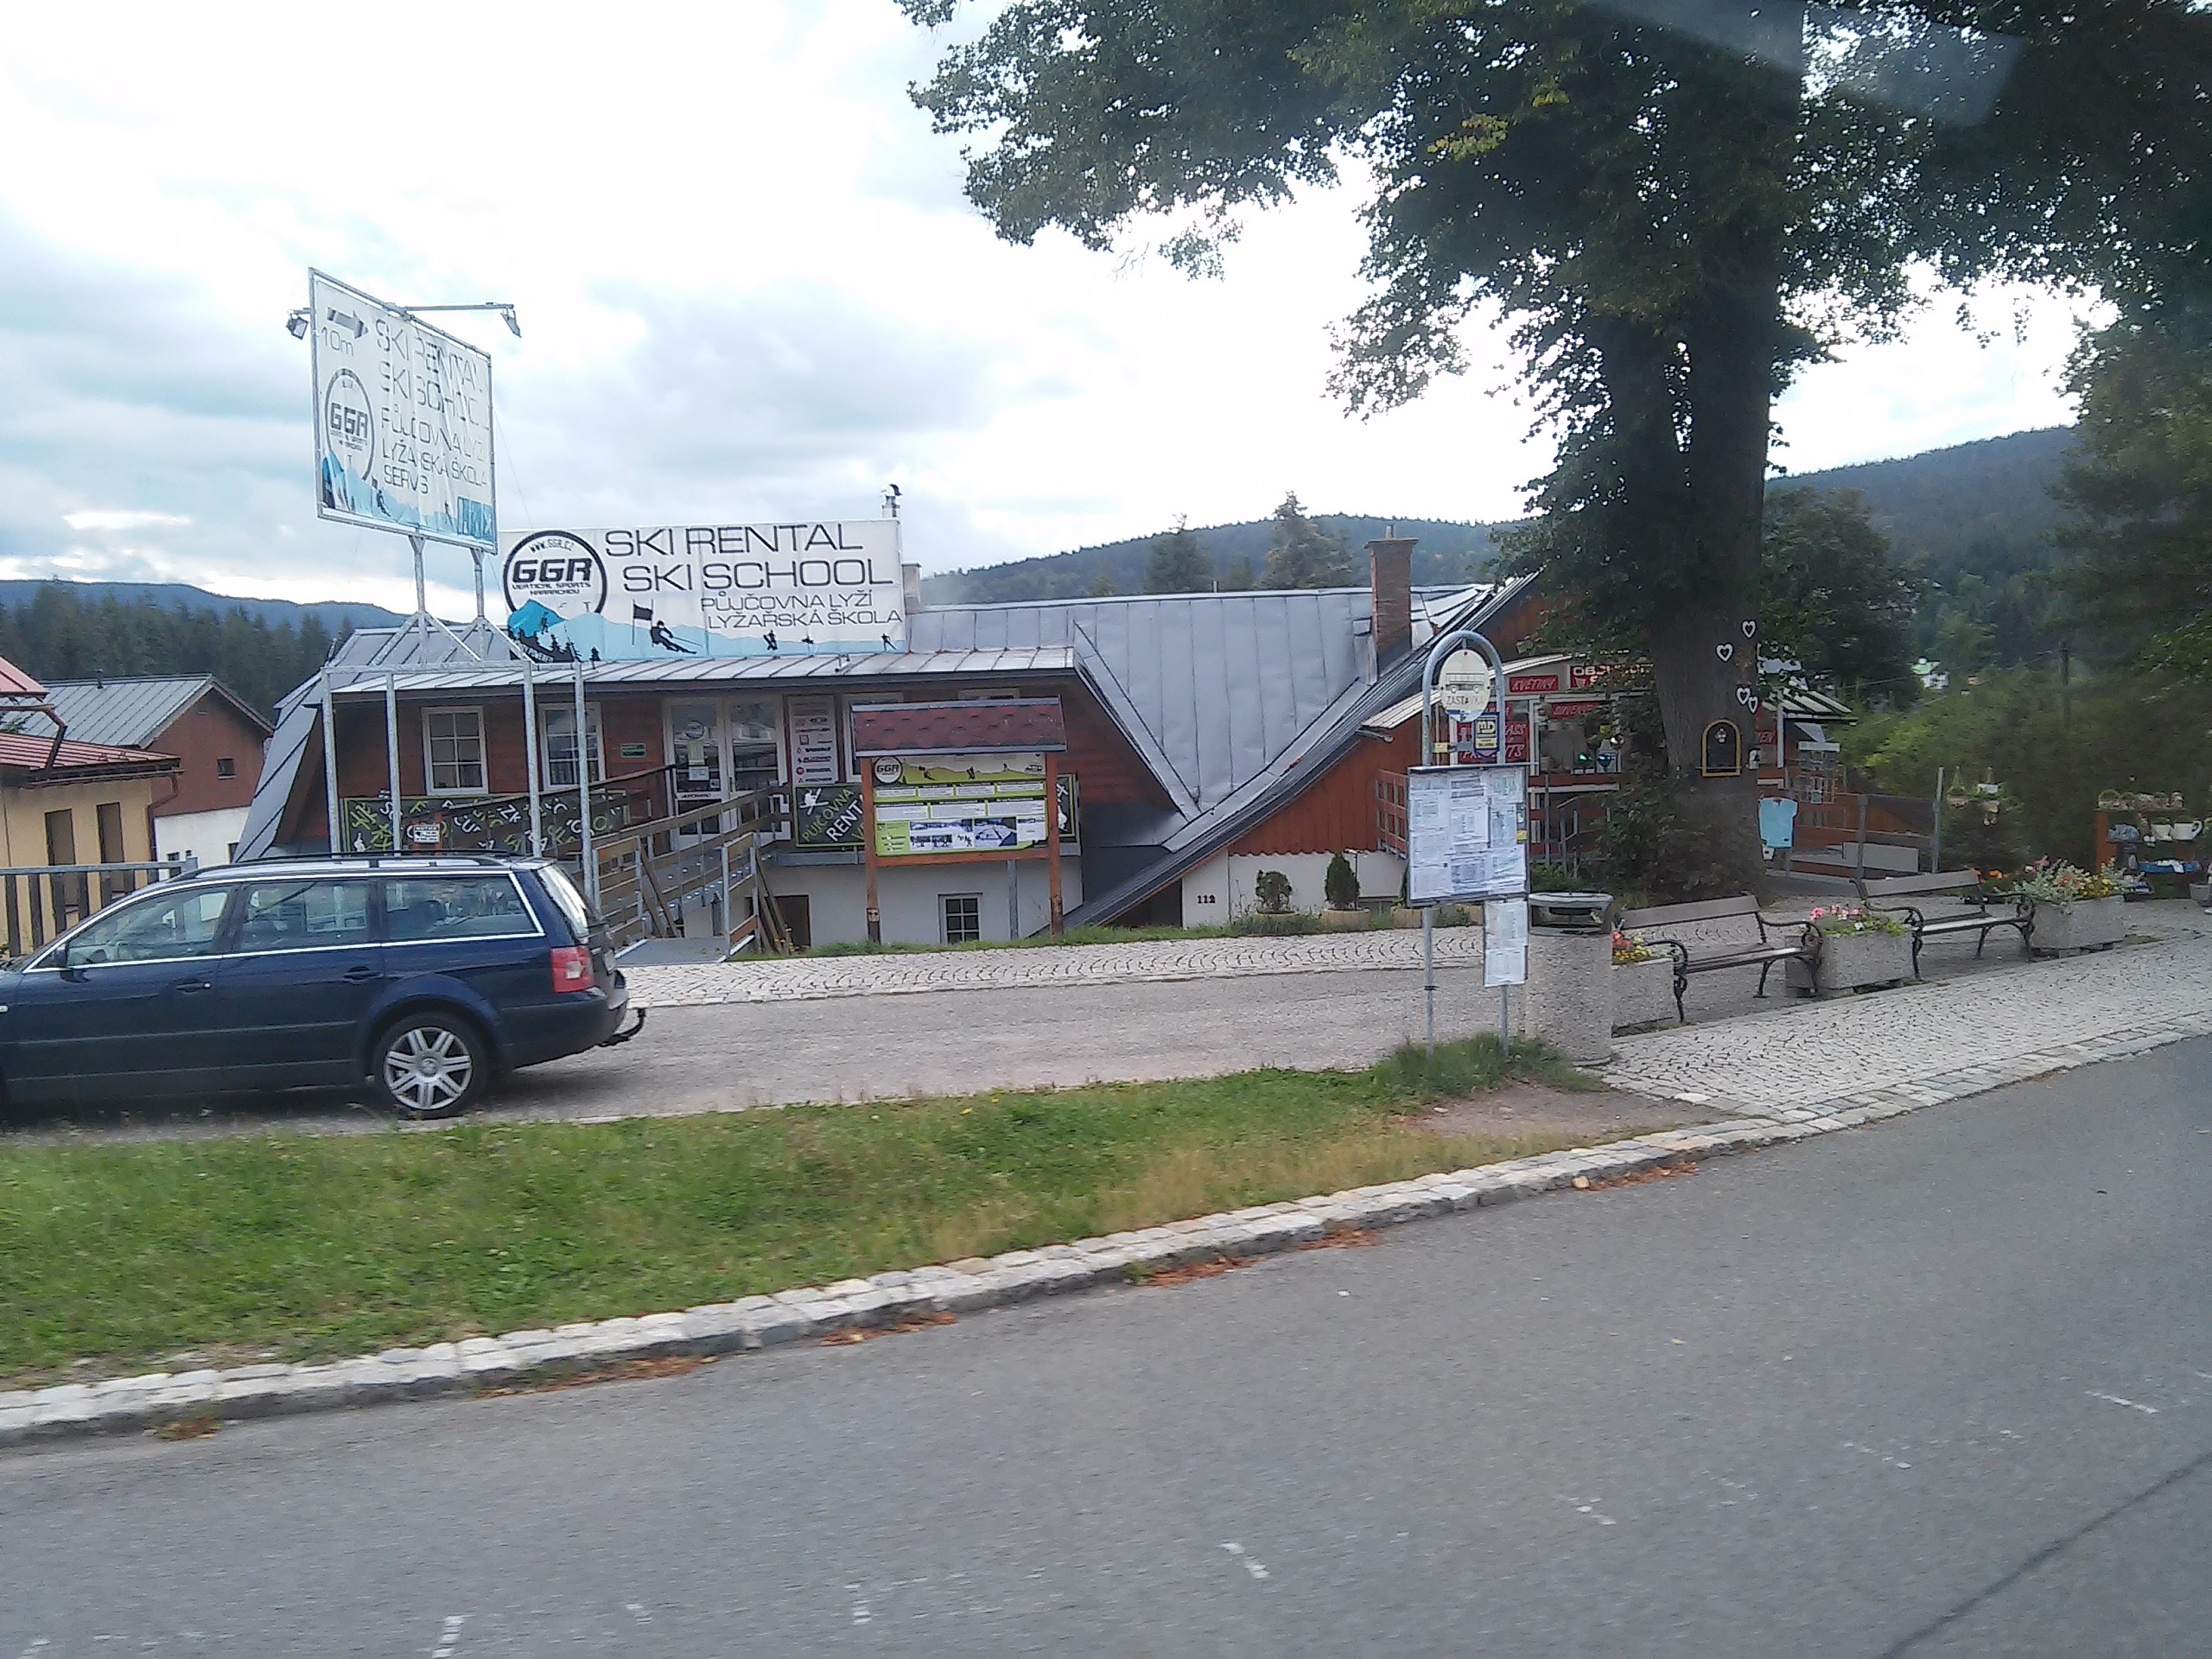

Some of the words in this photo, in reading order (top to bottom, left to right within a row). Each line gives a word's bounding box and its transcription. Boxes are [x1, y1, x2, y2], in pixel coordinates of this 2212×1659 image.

[320, 326, 354, 356] 10m
[376, 319, 409, 360] SKI
[605, 530, 675, 556] SKI
[686, 524, 864, 554] RENTAL
[513, 558, 592, 583] GGR
[623, 564, 692, 591] SKI
[703, 559, 893, 589] SCHOOL
[701, 591, 826, 611] PŮJČOVNA
[828, 589, 874, 608] LYŽÍ
[708, 607, 823, 629] LYŽAŘSKÁ
[828, 605, 903, 625] ŠKOLA
